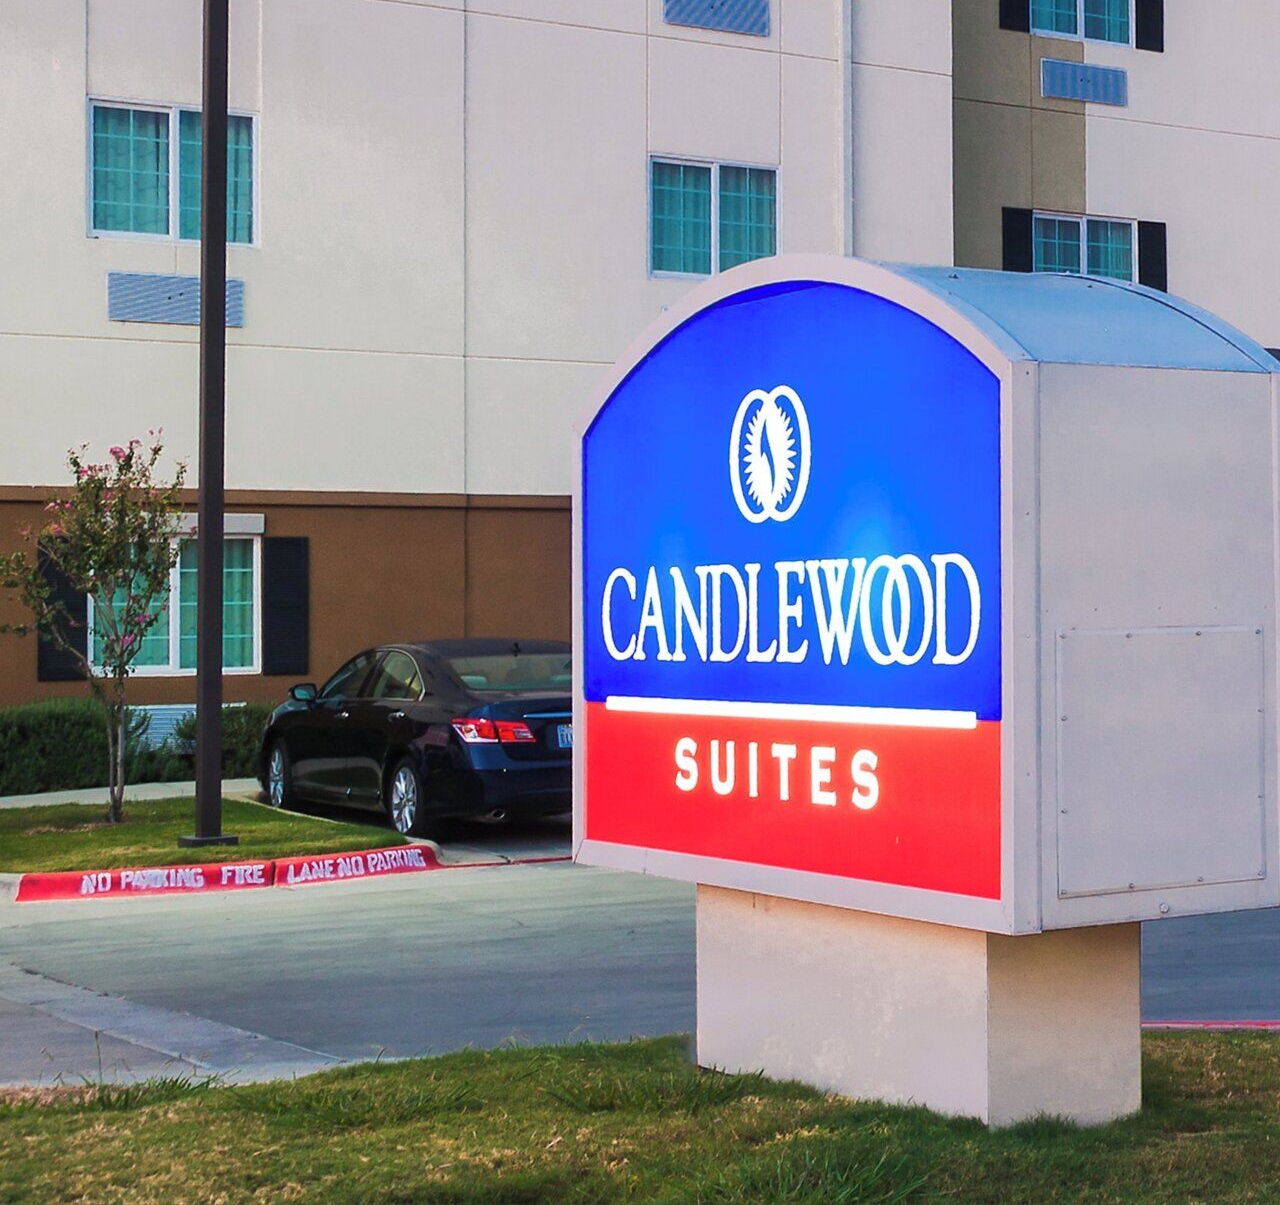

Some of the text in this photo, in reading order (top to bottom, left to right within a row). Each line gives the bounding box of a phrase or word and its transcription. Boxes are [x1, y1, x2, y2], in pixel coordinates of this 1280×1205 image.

[602, 553, 981, 666] CANDLEWOOD
[675, 736, 880, 810] SUITES
[80, 864, 265, 895] NO PARKING FIRE
[287, 848, 427, 885] LANE NO PARKING
